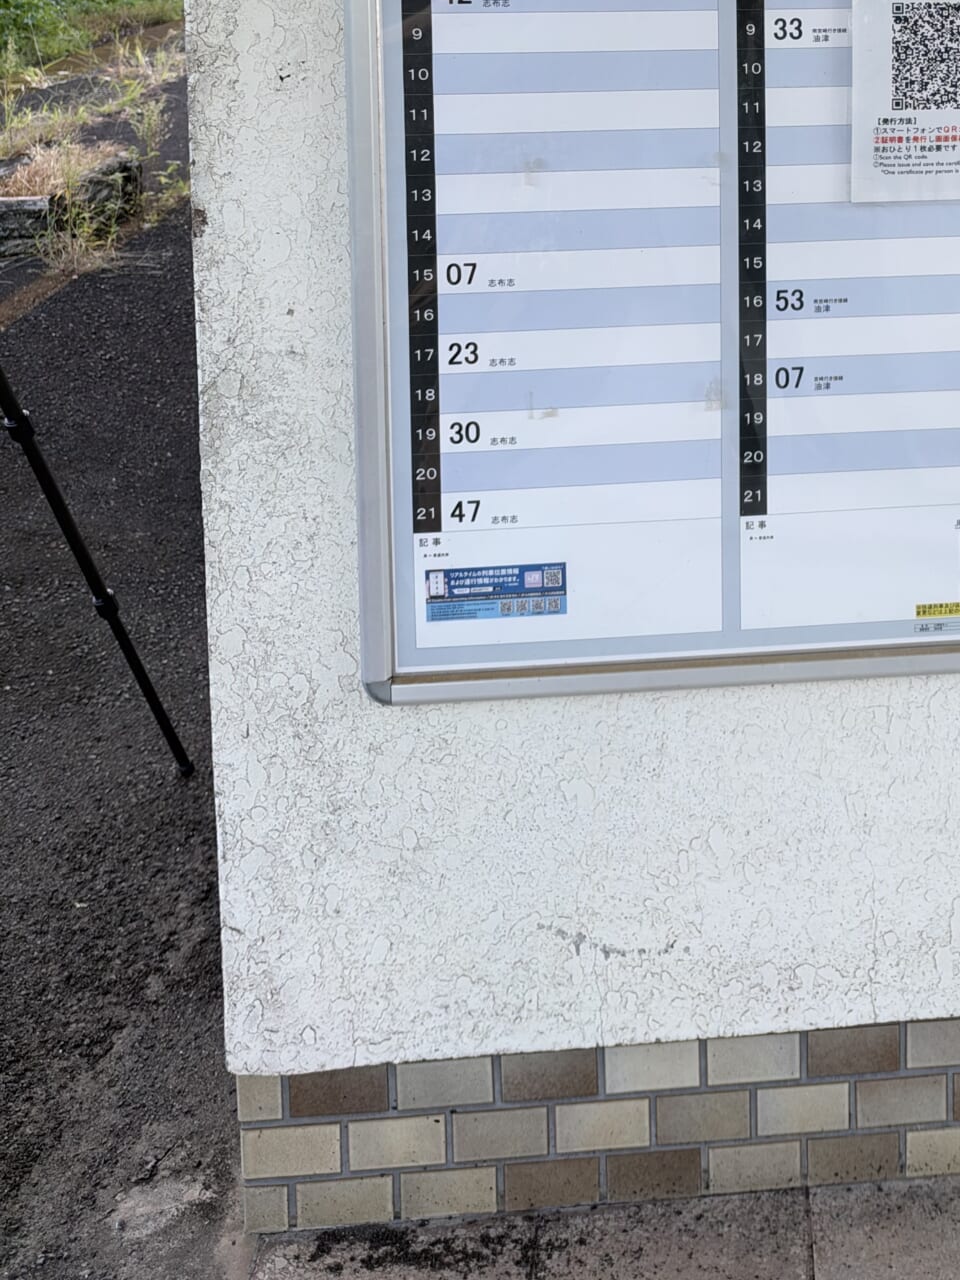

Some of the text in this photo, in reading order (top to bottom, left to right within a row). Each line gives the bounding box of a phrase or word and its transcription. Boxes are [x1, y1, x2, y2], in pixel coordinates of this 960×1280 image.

[482, 0, 510, 8] 志布志
[773, 18, 830, 43] 33 油津
[446, 262, 516, 287] 07 志布志
[775, 289, 831, 313] 53 油津
[447, 342, 517, 367] 23 志布志
[775, 366, 831, 391] 07 油津
[449, 421, 518, 446] 30 志布志
[450, 500, 519, 525] 47 志布志
